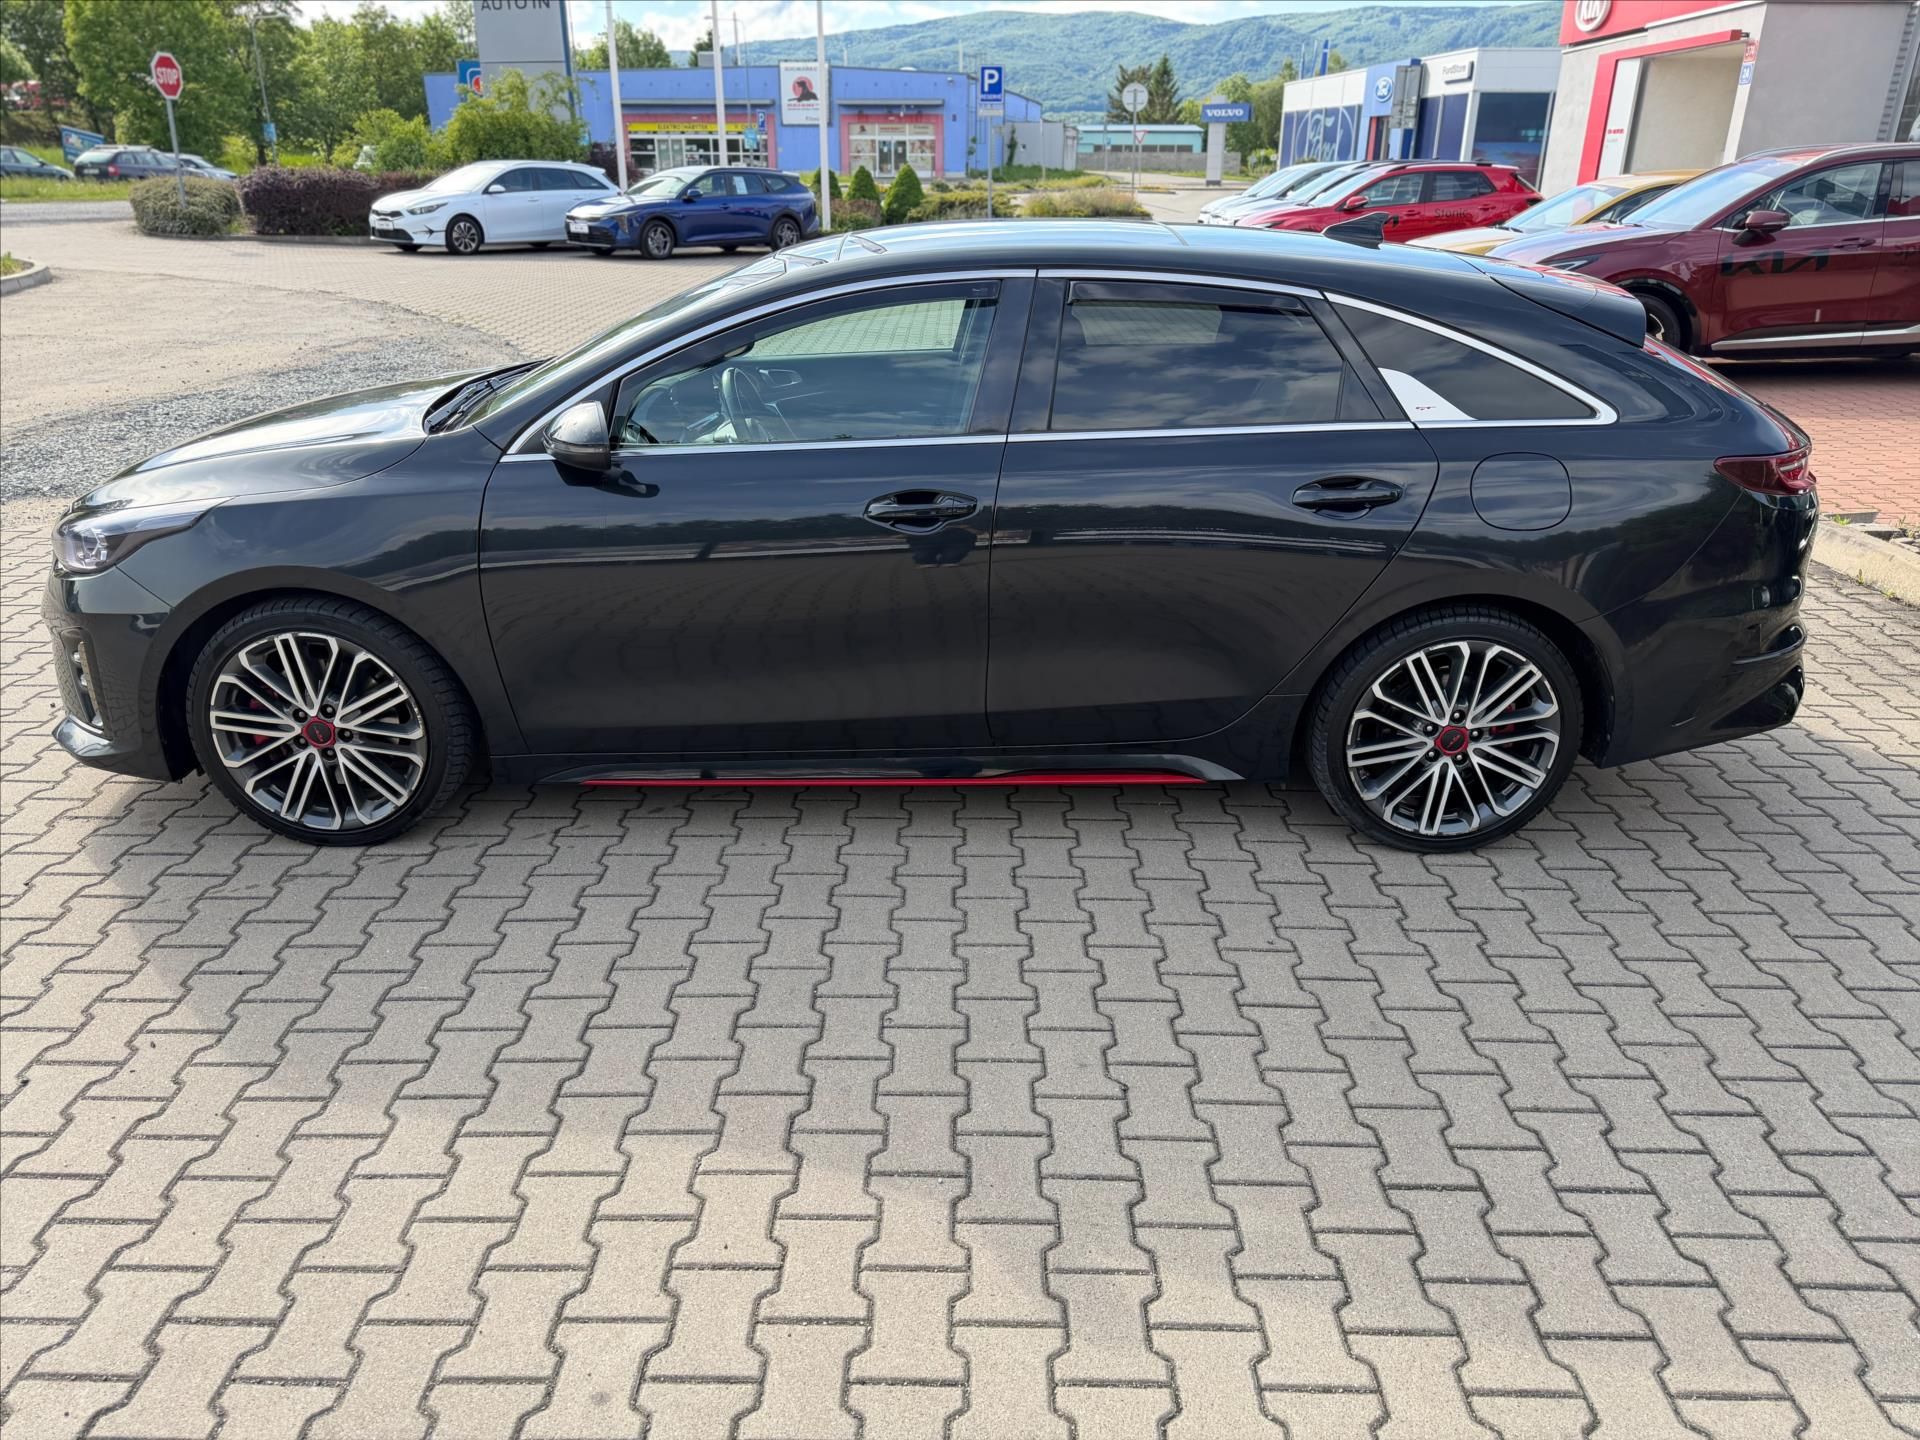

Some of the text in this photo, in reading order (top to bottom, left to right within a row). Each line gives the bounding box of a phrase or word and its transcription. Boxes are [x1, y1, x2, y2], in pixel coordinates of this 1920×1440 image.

[156, 67, 178, 85] STOP
[984, 69, 999, 92] P
[1206, 108, 1244, 117] VOLVO
